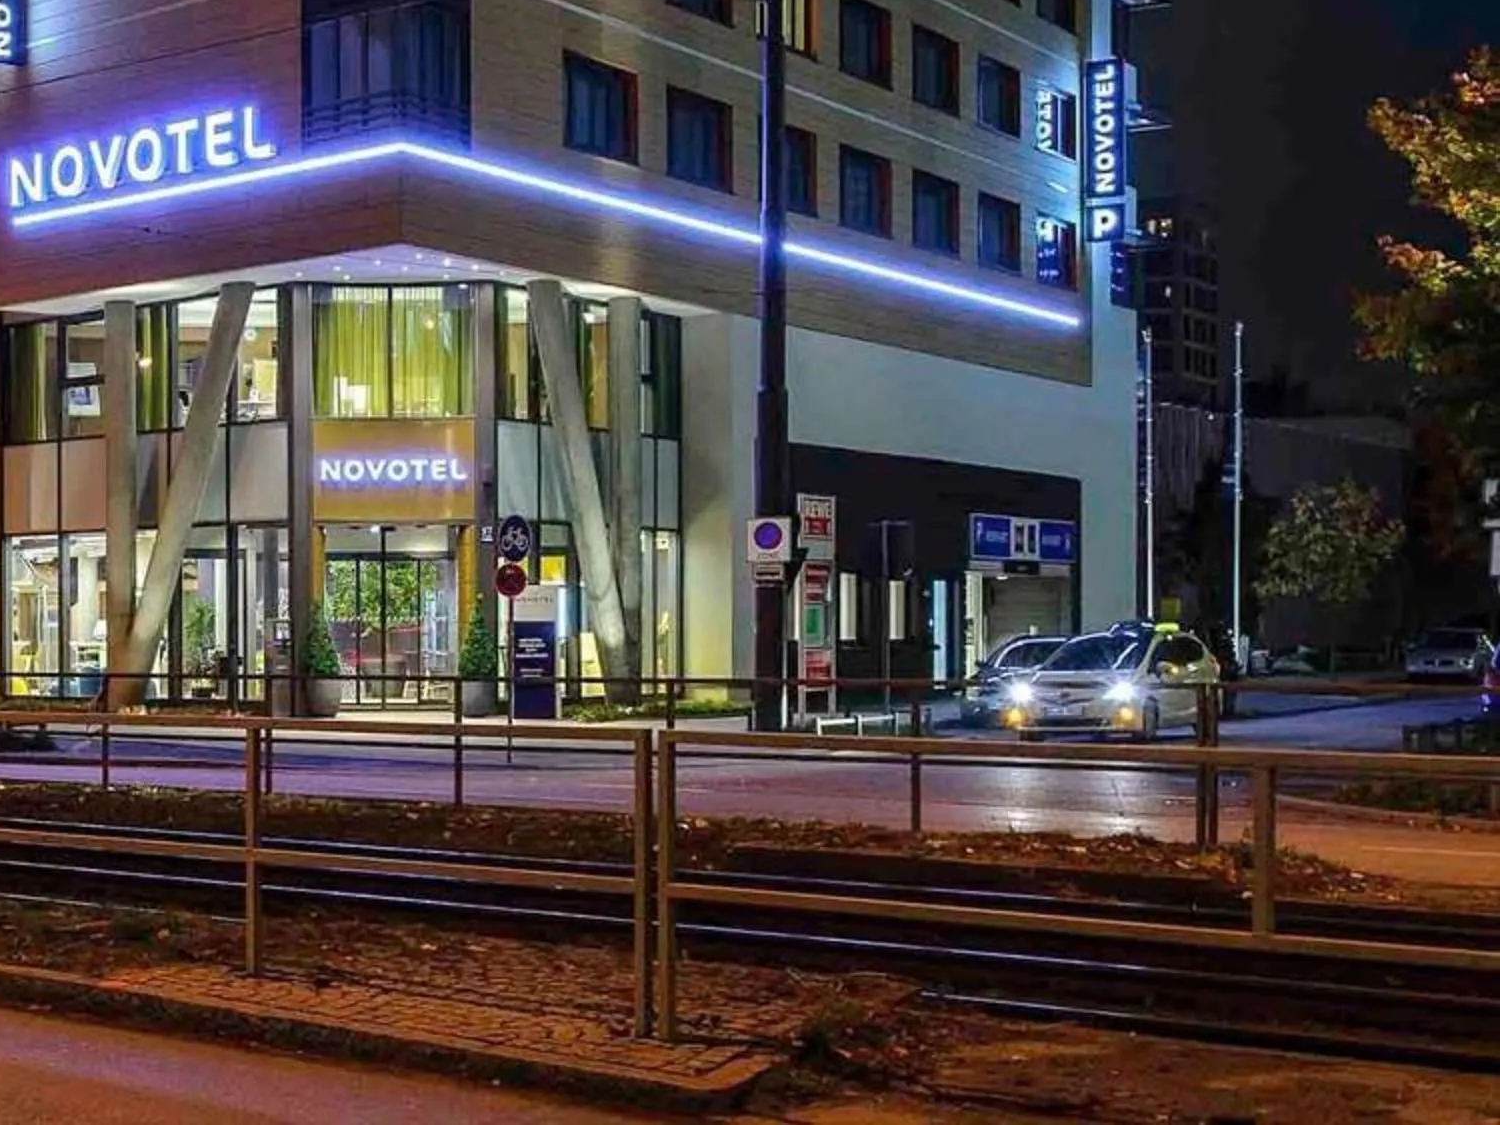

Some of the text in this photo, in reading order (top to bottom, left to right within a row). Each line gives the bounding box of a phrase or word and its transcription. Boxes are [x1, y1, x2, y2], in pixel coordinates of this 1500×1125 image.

[11, 106, 277, 207] NOVOTEL
[1095, 64, 1116, 194] NOVOTEL
[1093, 208, 1119, 238] P
[320, 458, 469, 482] NOVOTEL
